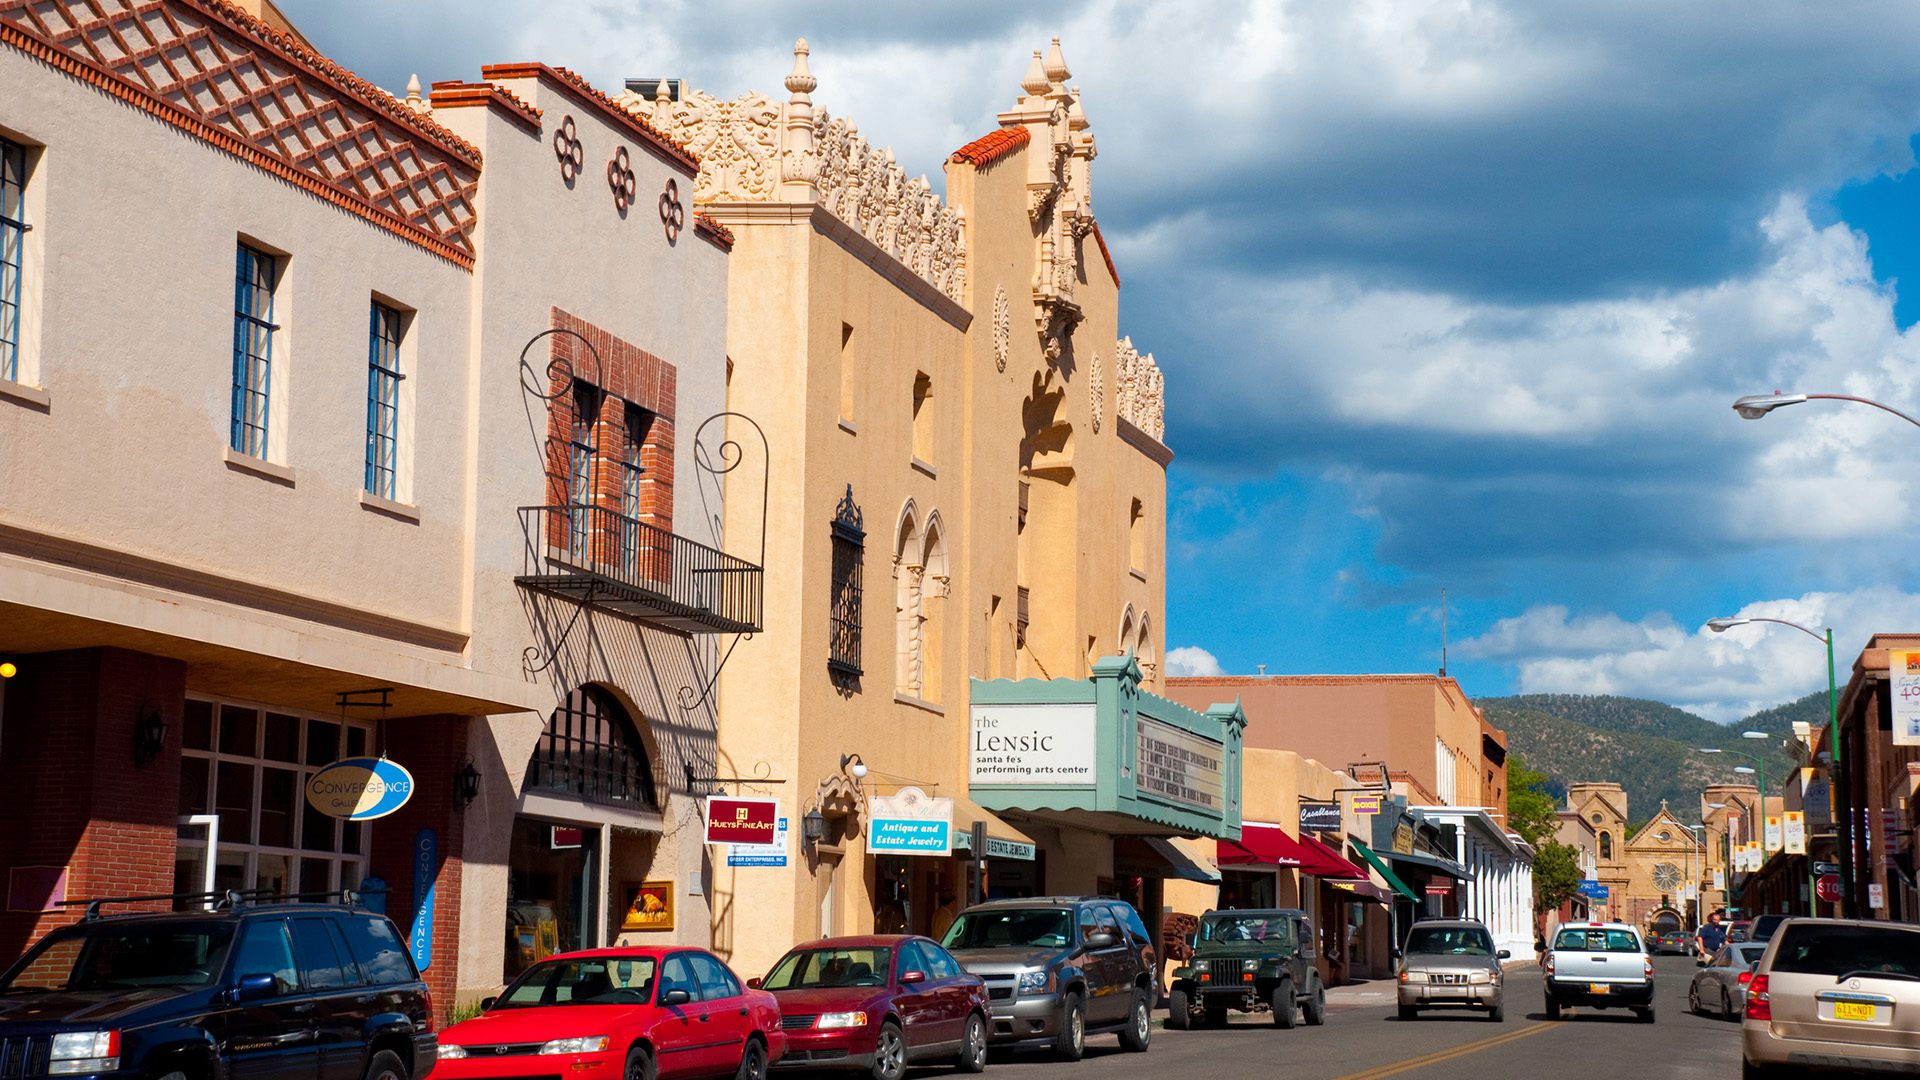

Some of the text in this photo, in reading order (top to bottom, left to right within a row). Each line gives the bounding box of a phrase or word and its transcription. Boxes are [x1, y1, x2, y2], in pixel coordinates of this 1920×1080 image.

[975, 716, 999, 728] The
[976, 766, 1032, 775] performing
[1300, 806, 1340, 822] Casablanca
[882, 823, 940, 834] Antique and
[876, 835, 944, 847] Estate Jewelry
[1818, 881, 1840, 893] STO
